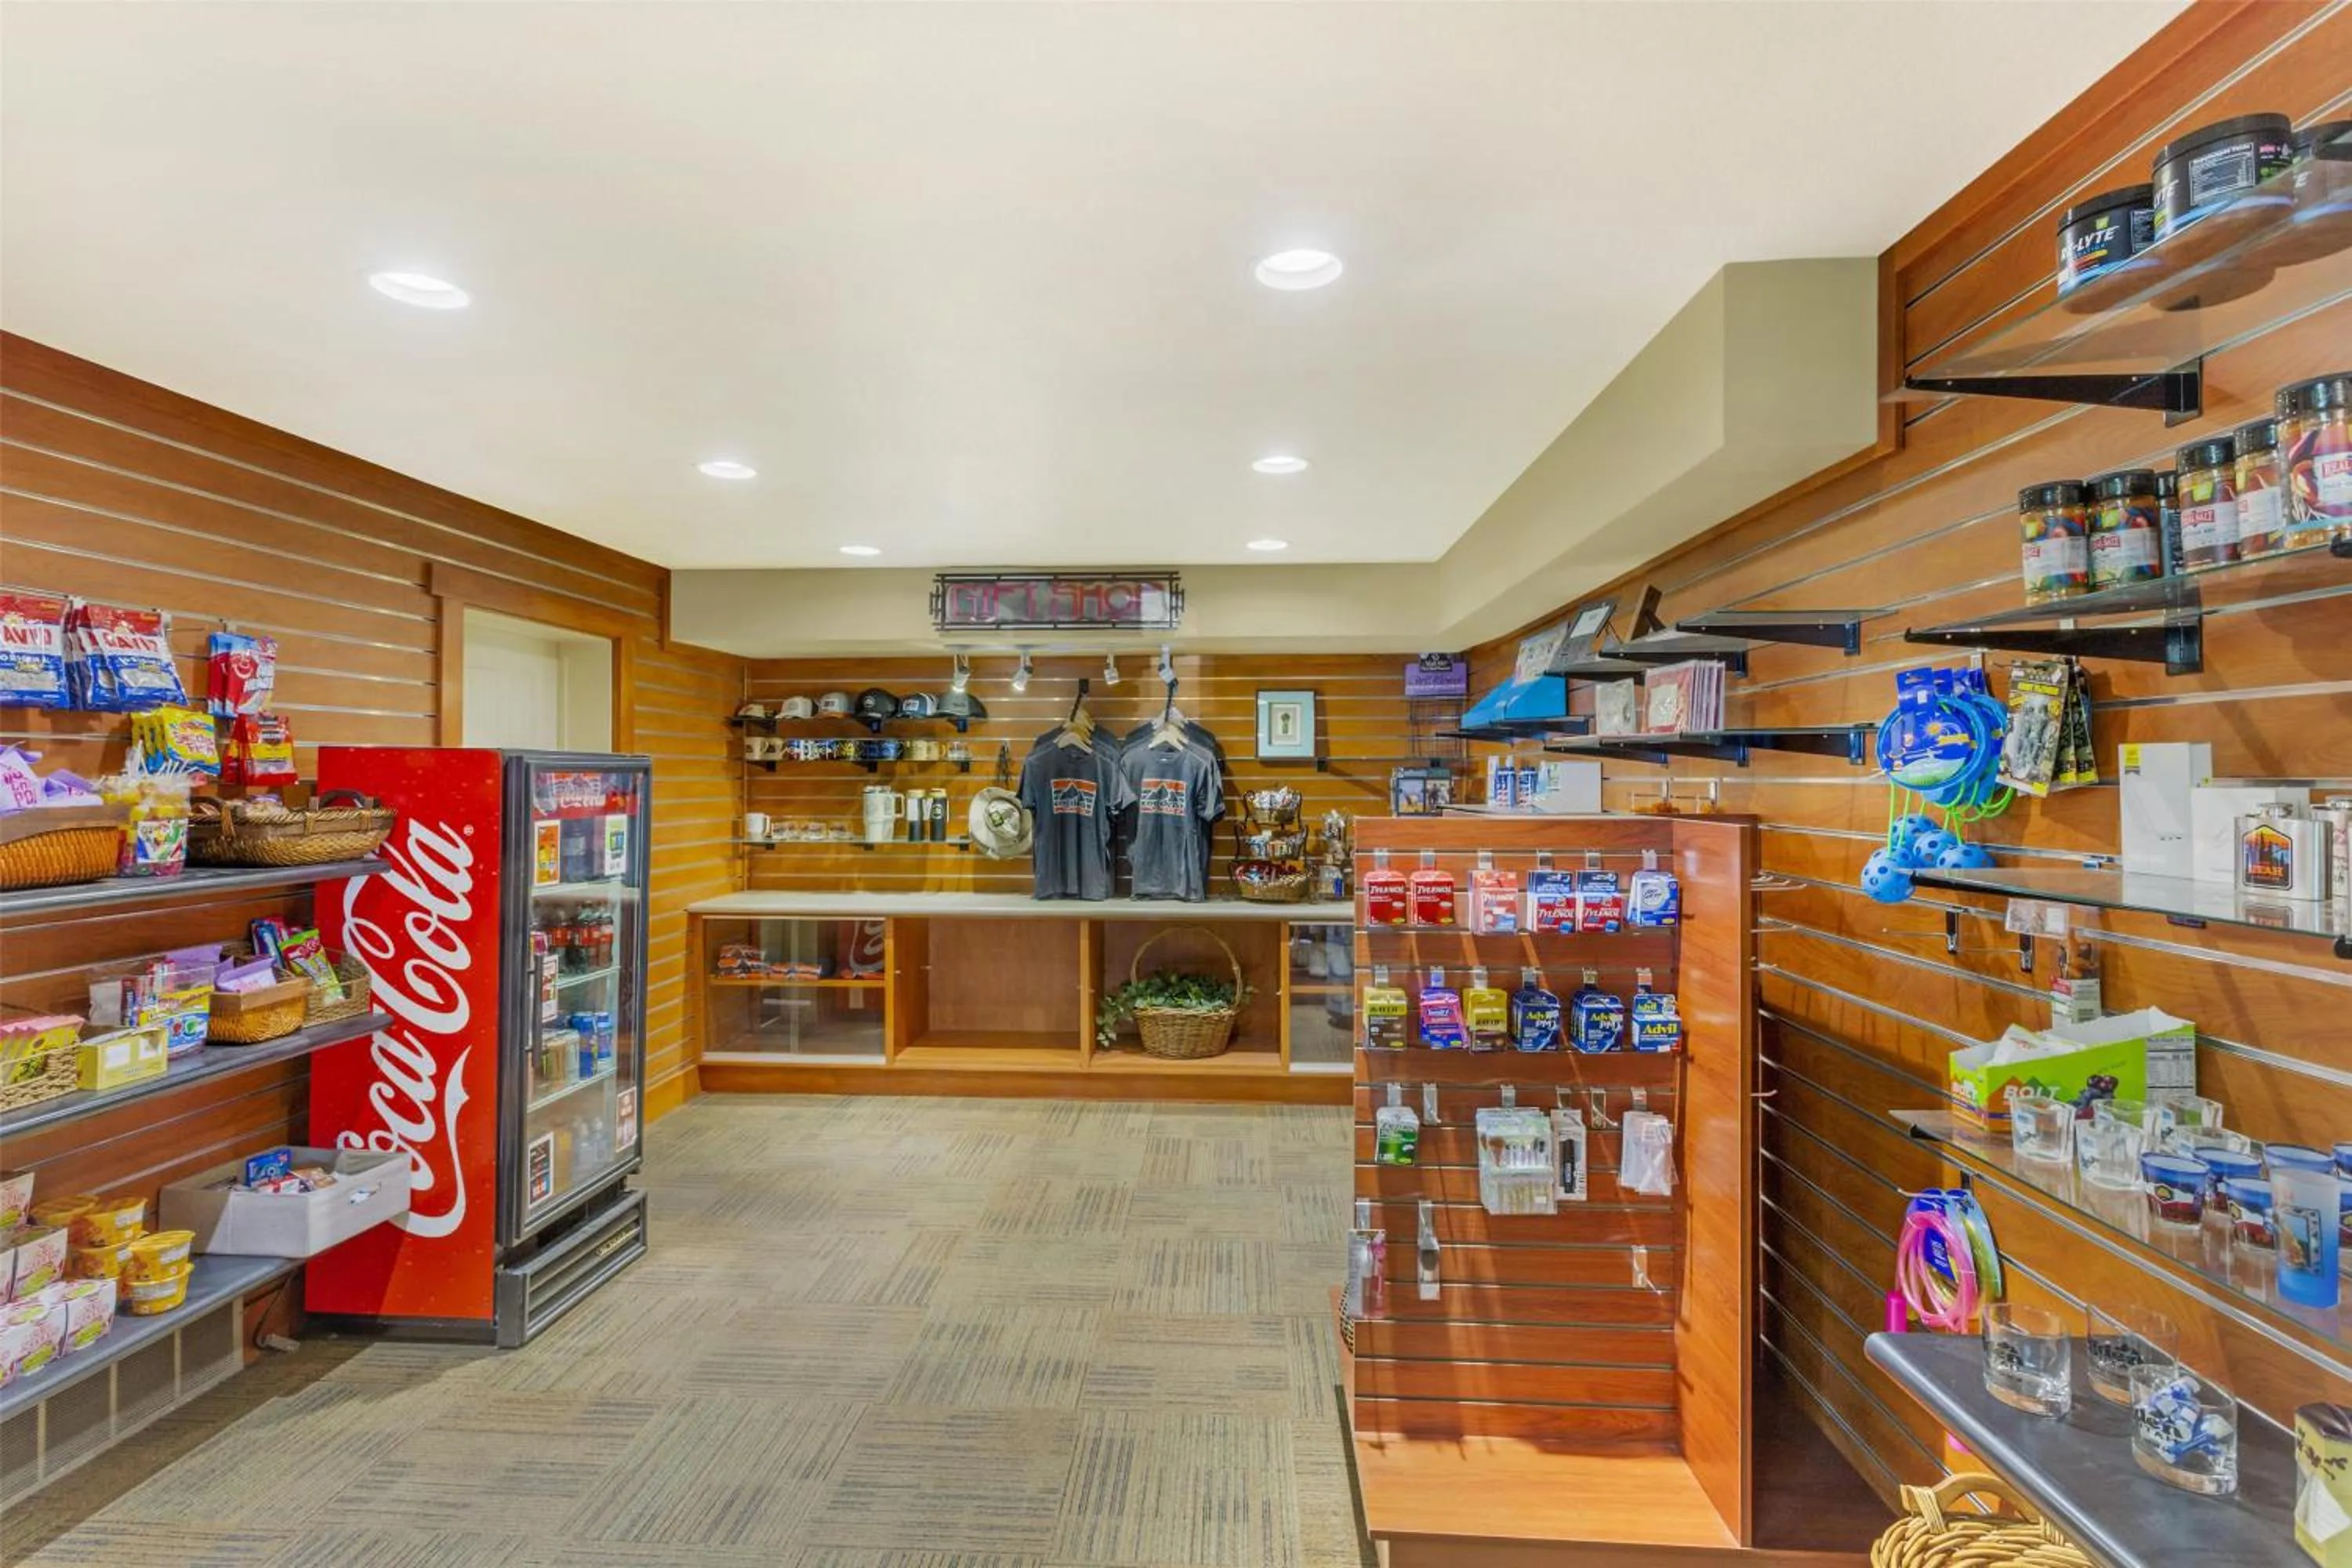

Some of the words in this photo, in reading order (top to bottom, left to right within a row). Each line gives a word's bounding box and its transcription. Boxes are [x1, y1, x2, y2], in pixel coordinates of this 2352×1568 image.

[2, 625, 52, 645] AVID
[1643, 1023, 1678, 1034] Advil
[2003, 1084, 2061, 1099] BOLT
